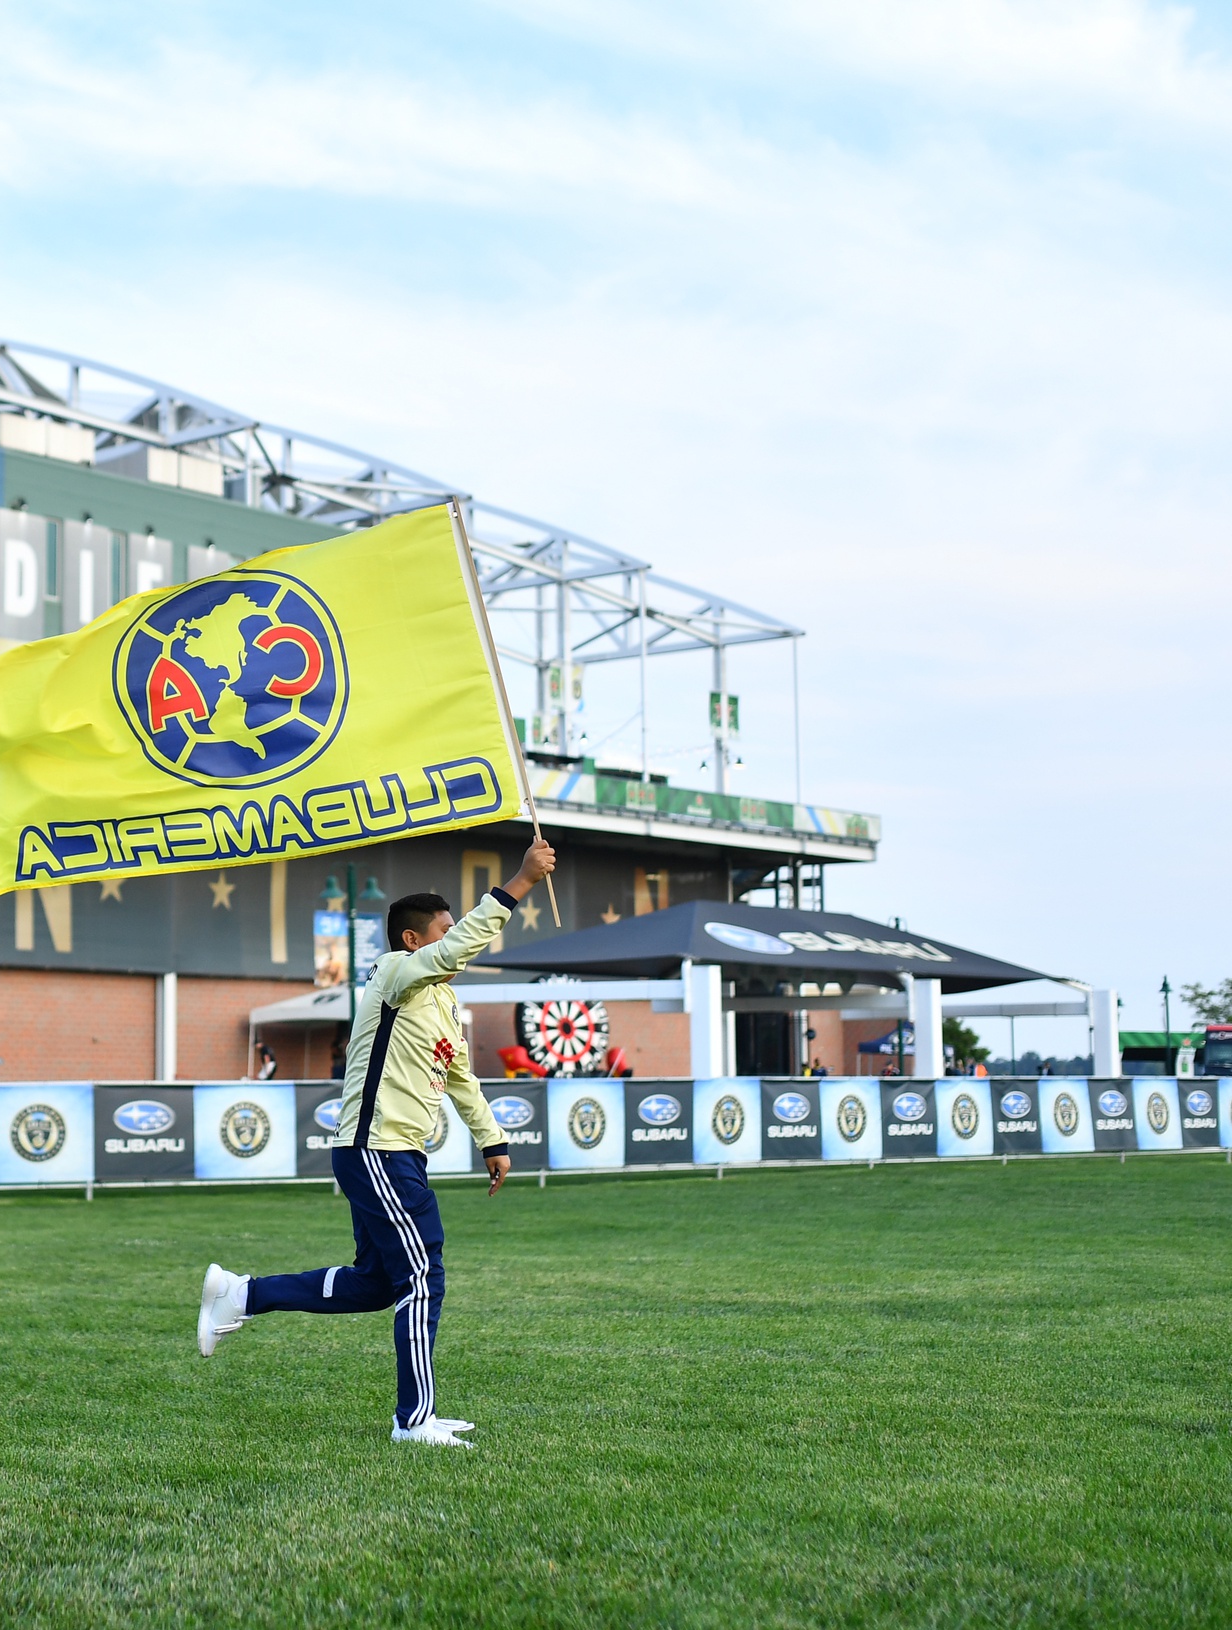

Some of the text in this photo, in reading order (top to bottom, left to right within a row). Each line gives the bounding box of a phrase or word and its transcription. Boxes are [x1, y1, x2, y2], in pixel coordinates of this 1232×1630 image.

[777, 931, 953, 963] SUBARU
[887, 1123, 934, 1137] SUBARU
[997, 1120, 1037, 1133] SUBARU
[1096, 1118, 1134, 1131] SUBARU
[1183, 1117, 1217, 1129] SUBARU
[508, 1131, 542, 1145] ARU
[631, 1127, 687, 1142] SUBARU
[767, 1124, 817, 1138] SUBARU
[104, 1138, 185, 1153] SUBARU
